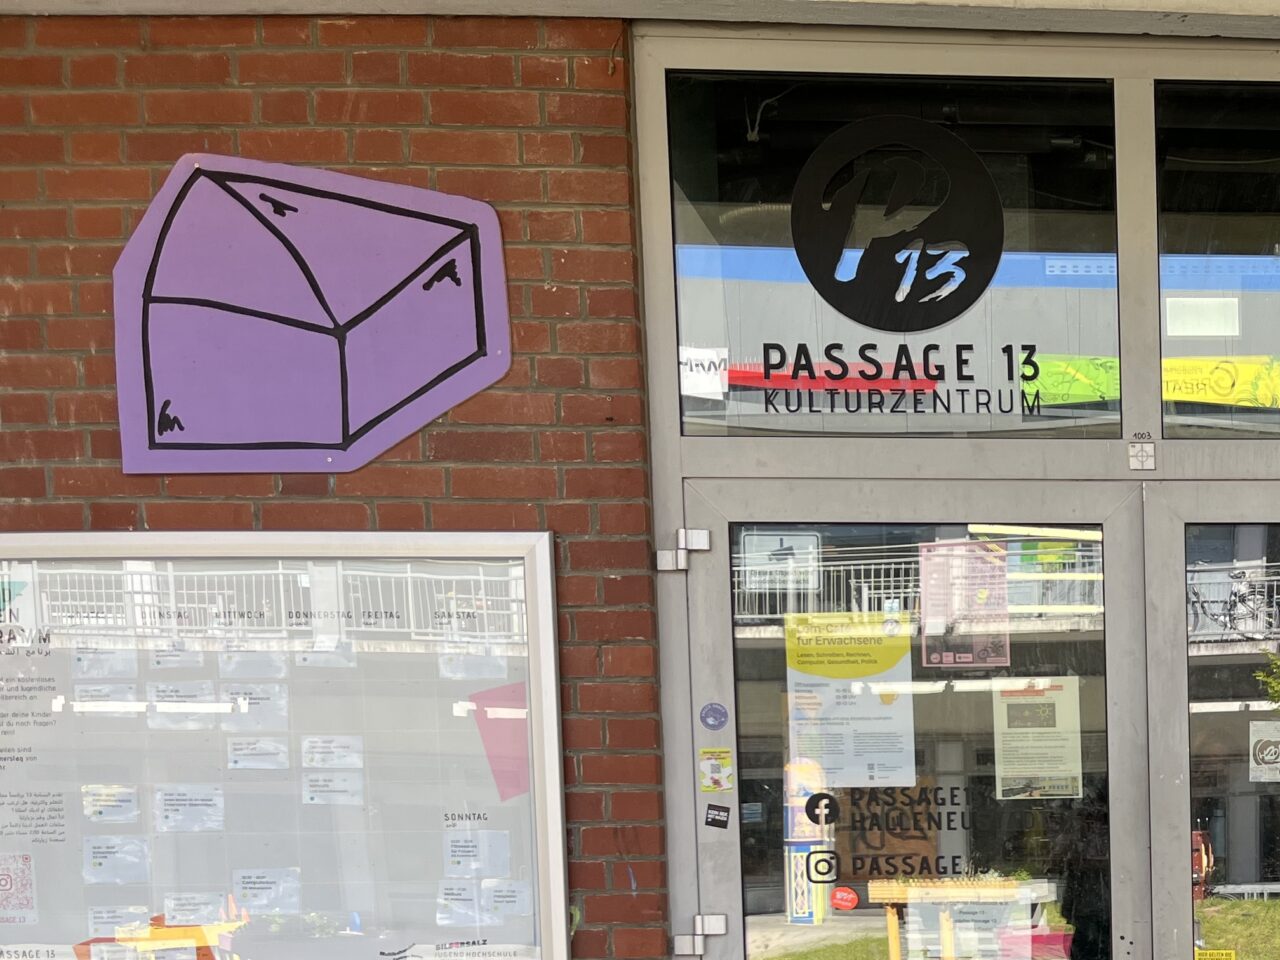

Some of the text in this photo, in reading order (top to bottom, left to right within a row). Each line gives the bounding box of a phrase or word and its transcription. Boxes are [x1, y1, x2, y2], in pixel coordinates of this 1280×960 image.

[895, 238, 970, 303] 13
[763, 343, 975, 381] PASSAGE
[1002, 344, 1040, 380] 13
[764, 388, 1041, 416] KULTURZENTRUM
[362, 611, 401, 619] FREITAG
[815, 635, 884, 646] Erwachsene
[443, 812, 489, 822] SONNTAG
